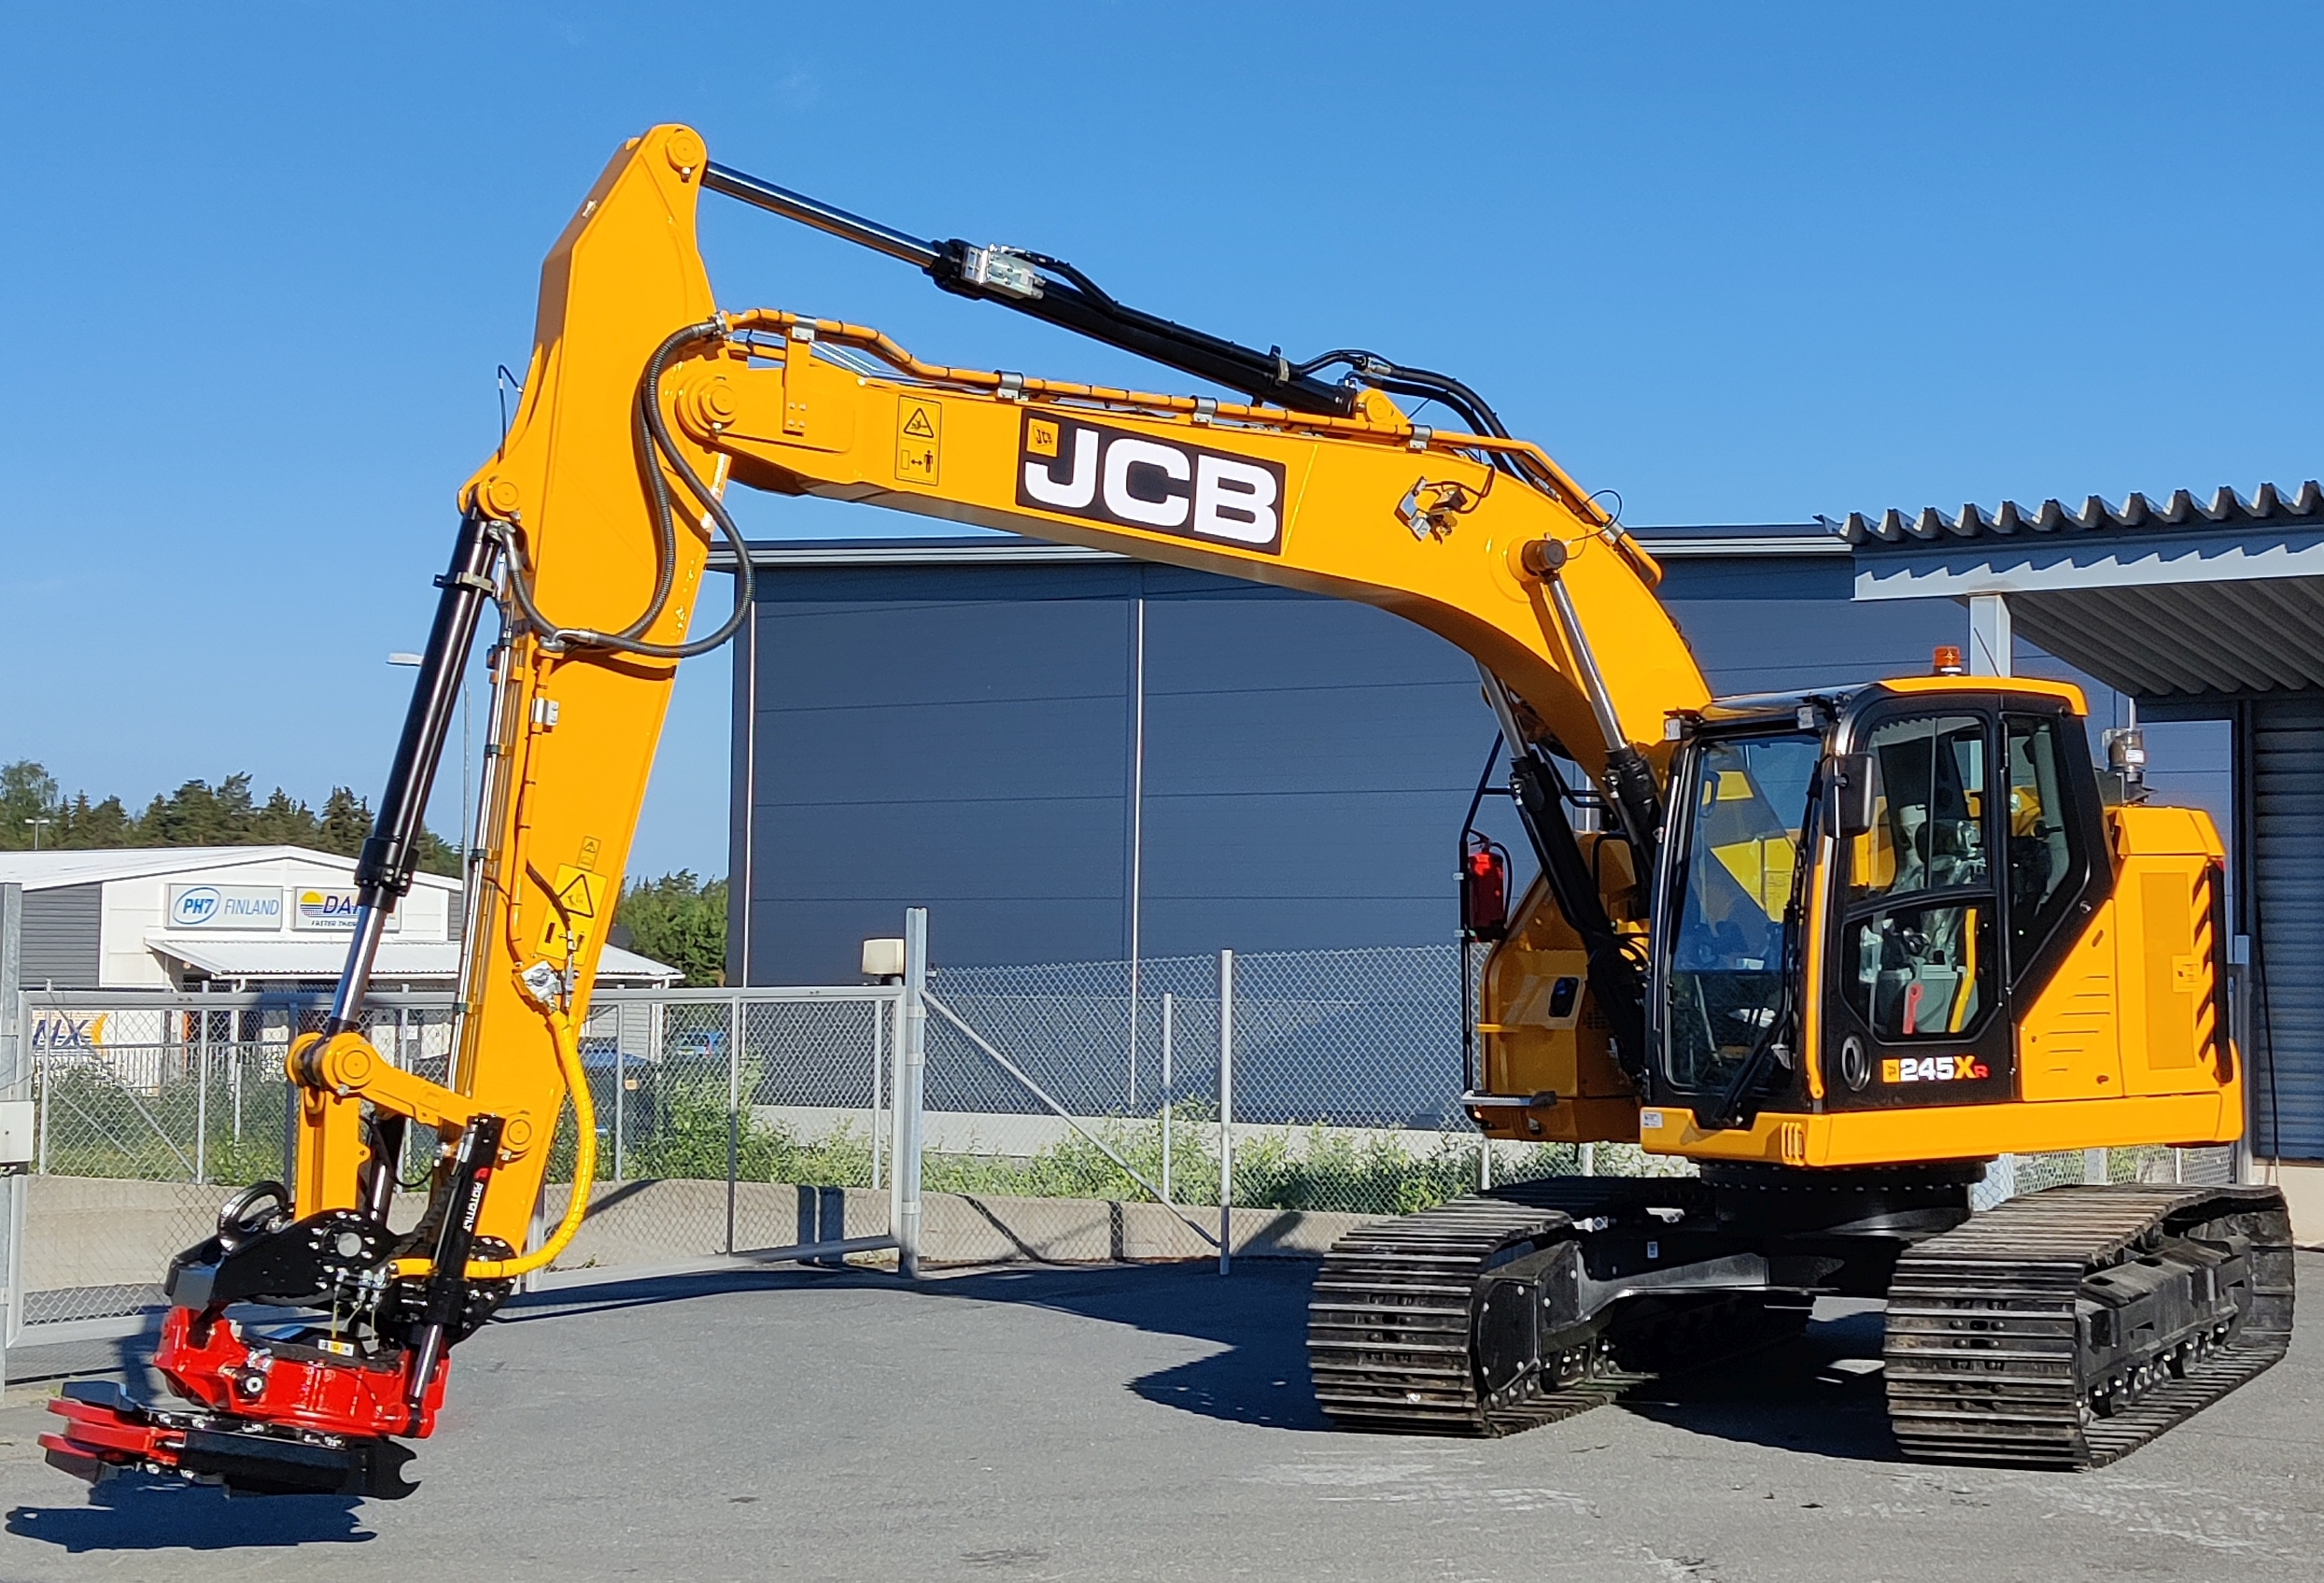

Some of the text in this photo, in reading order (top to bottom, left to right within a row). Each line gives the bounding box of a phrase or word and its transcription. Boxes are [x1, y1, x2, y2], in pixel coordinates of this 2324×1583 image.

[1024, 428, 1277, 544] JCB
[183, 898, 279, 915] PH7 FINLAND
